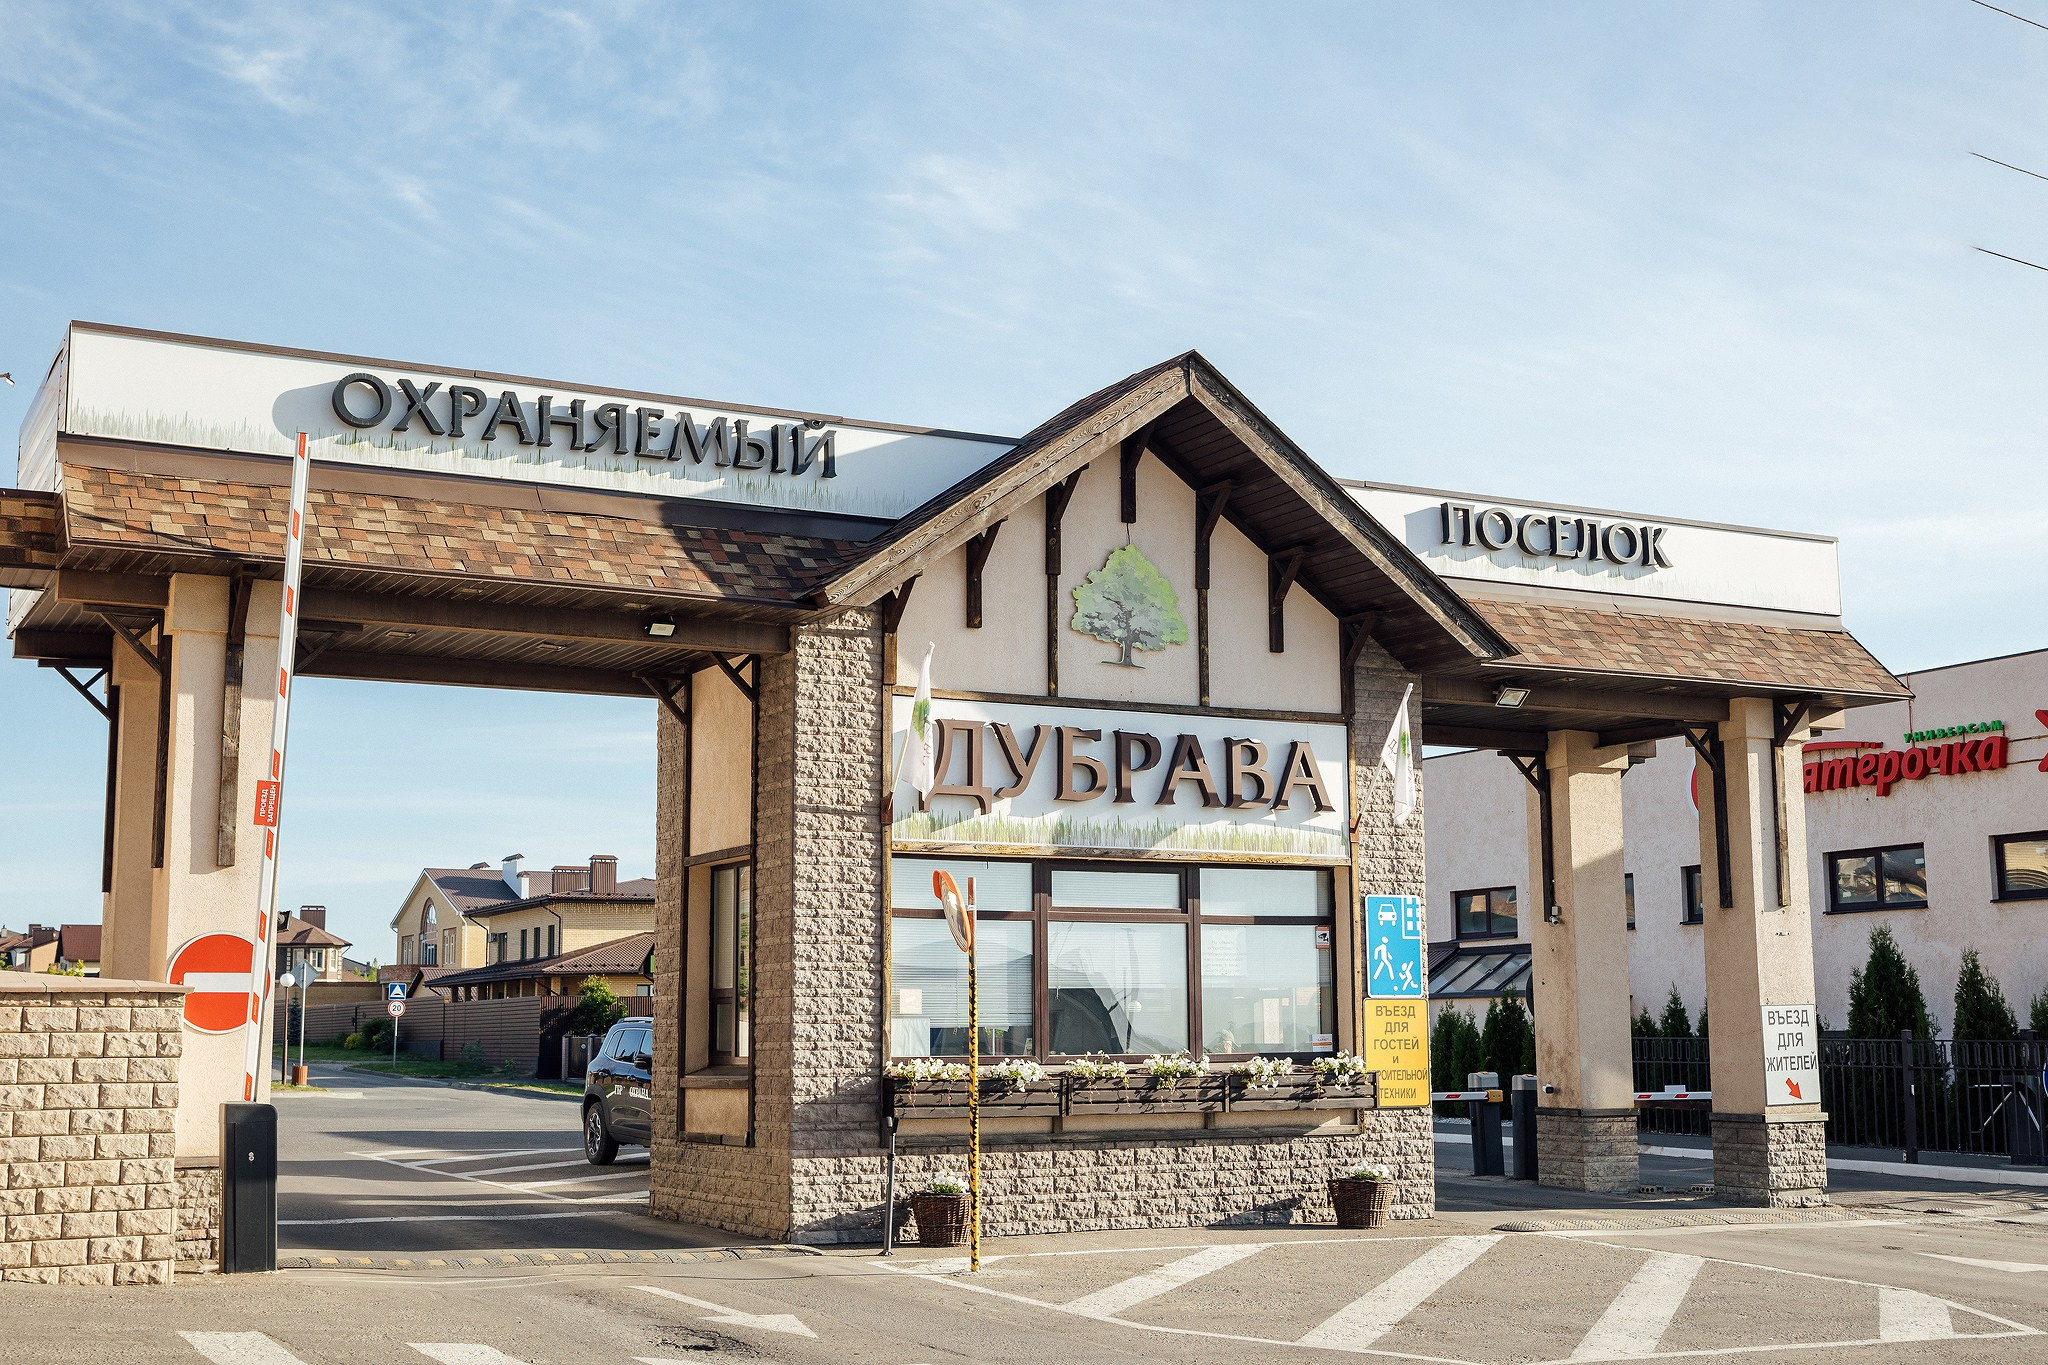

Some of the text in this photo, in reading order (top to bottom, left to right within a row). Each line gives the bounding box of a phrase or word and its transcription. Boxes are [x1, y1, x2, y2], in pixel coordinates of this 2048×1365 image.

[332, 372, 838, 479] ОХРАНЯЕМЫЙ
[1440, 501, 1674, 569] ПОСЕЛОК
[1903, 719, 2005, 744] УНИВЕРСАМ
[918, 717, 1337, 816] ДУБРАВА
[1802, 735, 2009, 797] ятёрочка
[259, 788, 269, 817] ПРОЕЗД
[266, 784, 277, 824] ЗАПРЕЩЕН
[392, 1004, 402, 1012] 20
[1375, 1005, 1416, 1019] ВЪЕЗД
[1767, 1009, 1810, 1027] ВЪЕЗД
[1384, 1021, 1409, 1035] ДЛЯ
[1373, 1036, 1419, 1050] ГОСТЕЙ
[1777, 1031, 1804, 1051] ДЛЯ
[1766, 1050, 1818, 1072] ЖИТЕЛЕЙ
[1379, 1067, 1428, 1081] ОИТЕЛЬНОЙ
[1379, 1087, 1417, 1099] ТЕХНИКИ
